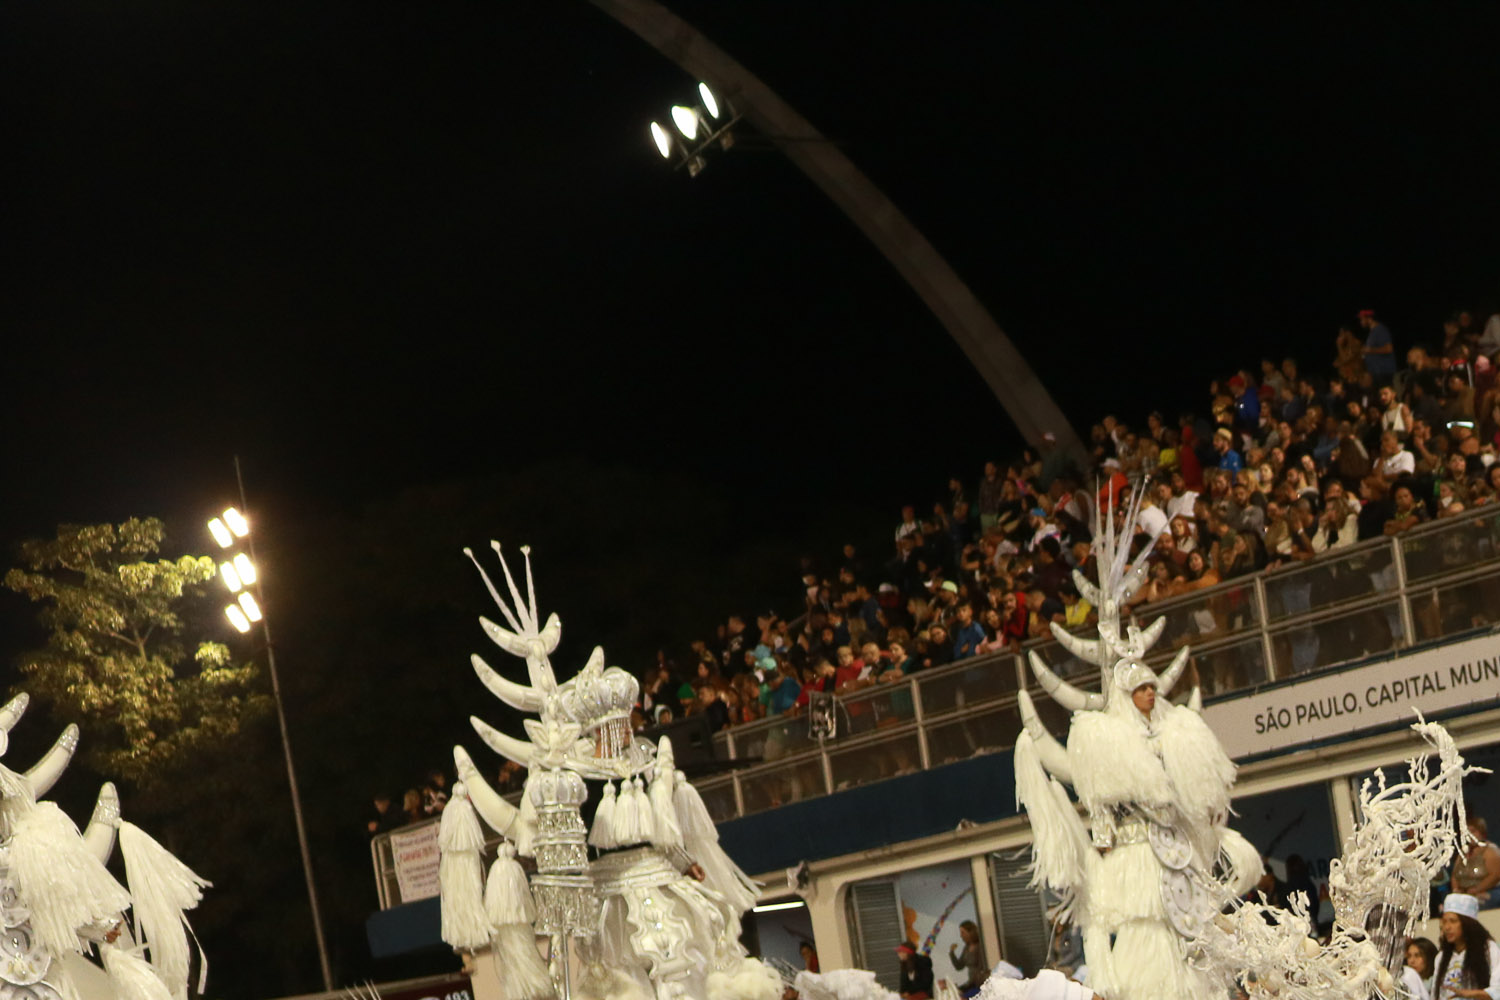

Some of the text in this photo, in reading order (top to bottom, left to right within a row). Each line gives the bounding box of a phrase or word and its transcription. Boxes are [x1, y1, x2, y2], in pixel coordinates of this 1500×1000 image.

[1254, 706, 1292, 735] SÃO
[1295, 692, 1363, 726] PAULO,
[1365, 671, 1446, 708] CAPITAL
